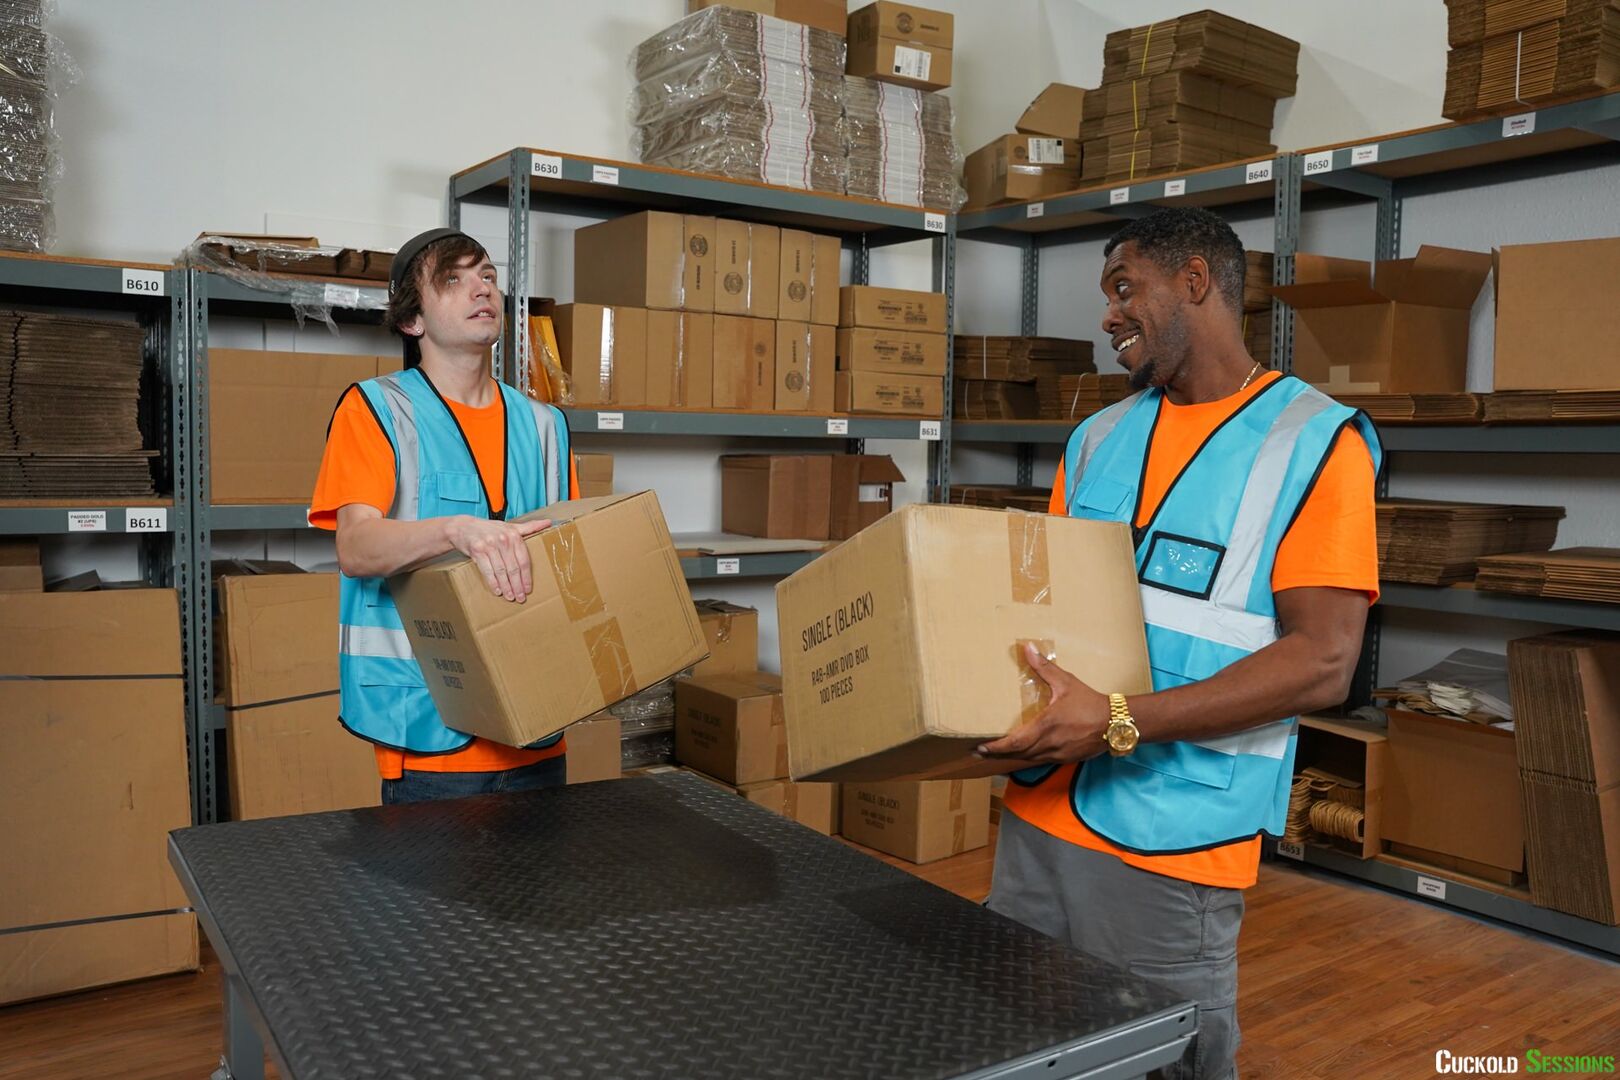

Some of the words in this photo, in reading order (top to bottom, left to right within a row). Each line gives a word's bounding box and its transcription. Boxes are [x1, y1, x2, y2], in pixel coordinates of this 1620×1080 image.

[534, 162, 559, 175] B630
[1307, 159, 1329, 172] B650
[1248, 169, 1270, 181] B640
[926, 219, 943, 231] B630
[126, 279, 159, 292] B610
[921, 427, 938, 437] B631
[130, 518, 161, 529] B611
[802, 615, 833, 652] SINGLE
[834, 591, 874, 636] (BLACK)
[840, 652, 854, 674] DVD
[855, 644, 870, 665] BOX
[819, 687, 830, 705] 100
[831, 676, 854, 701] PIECES
